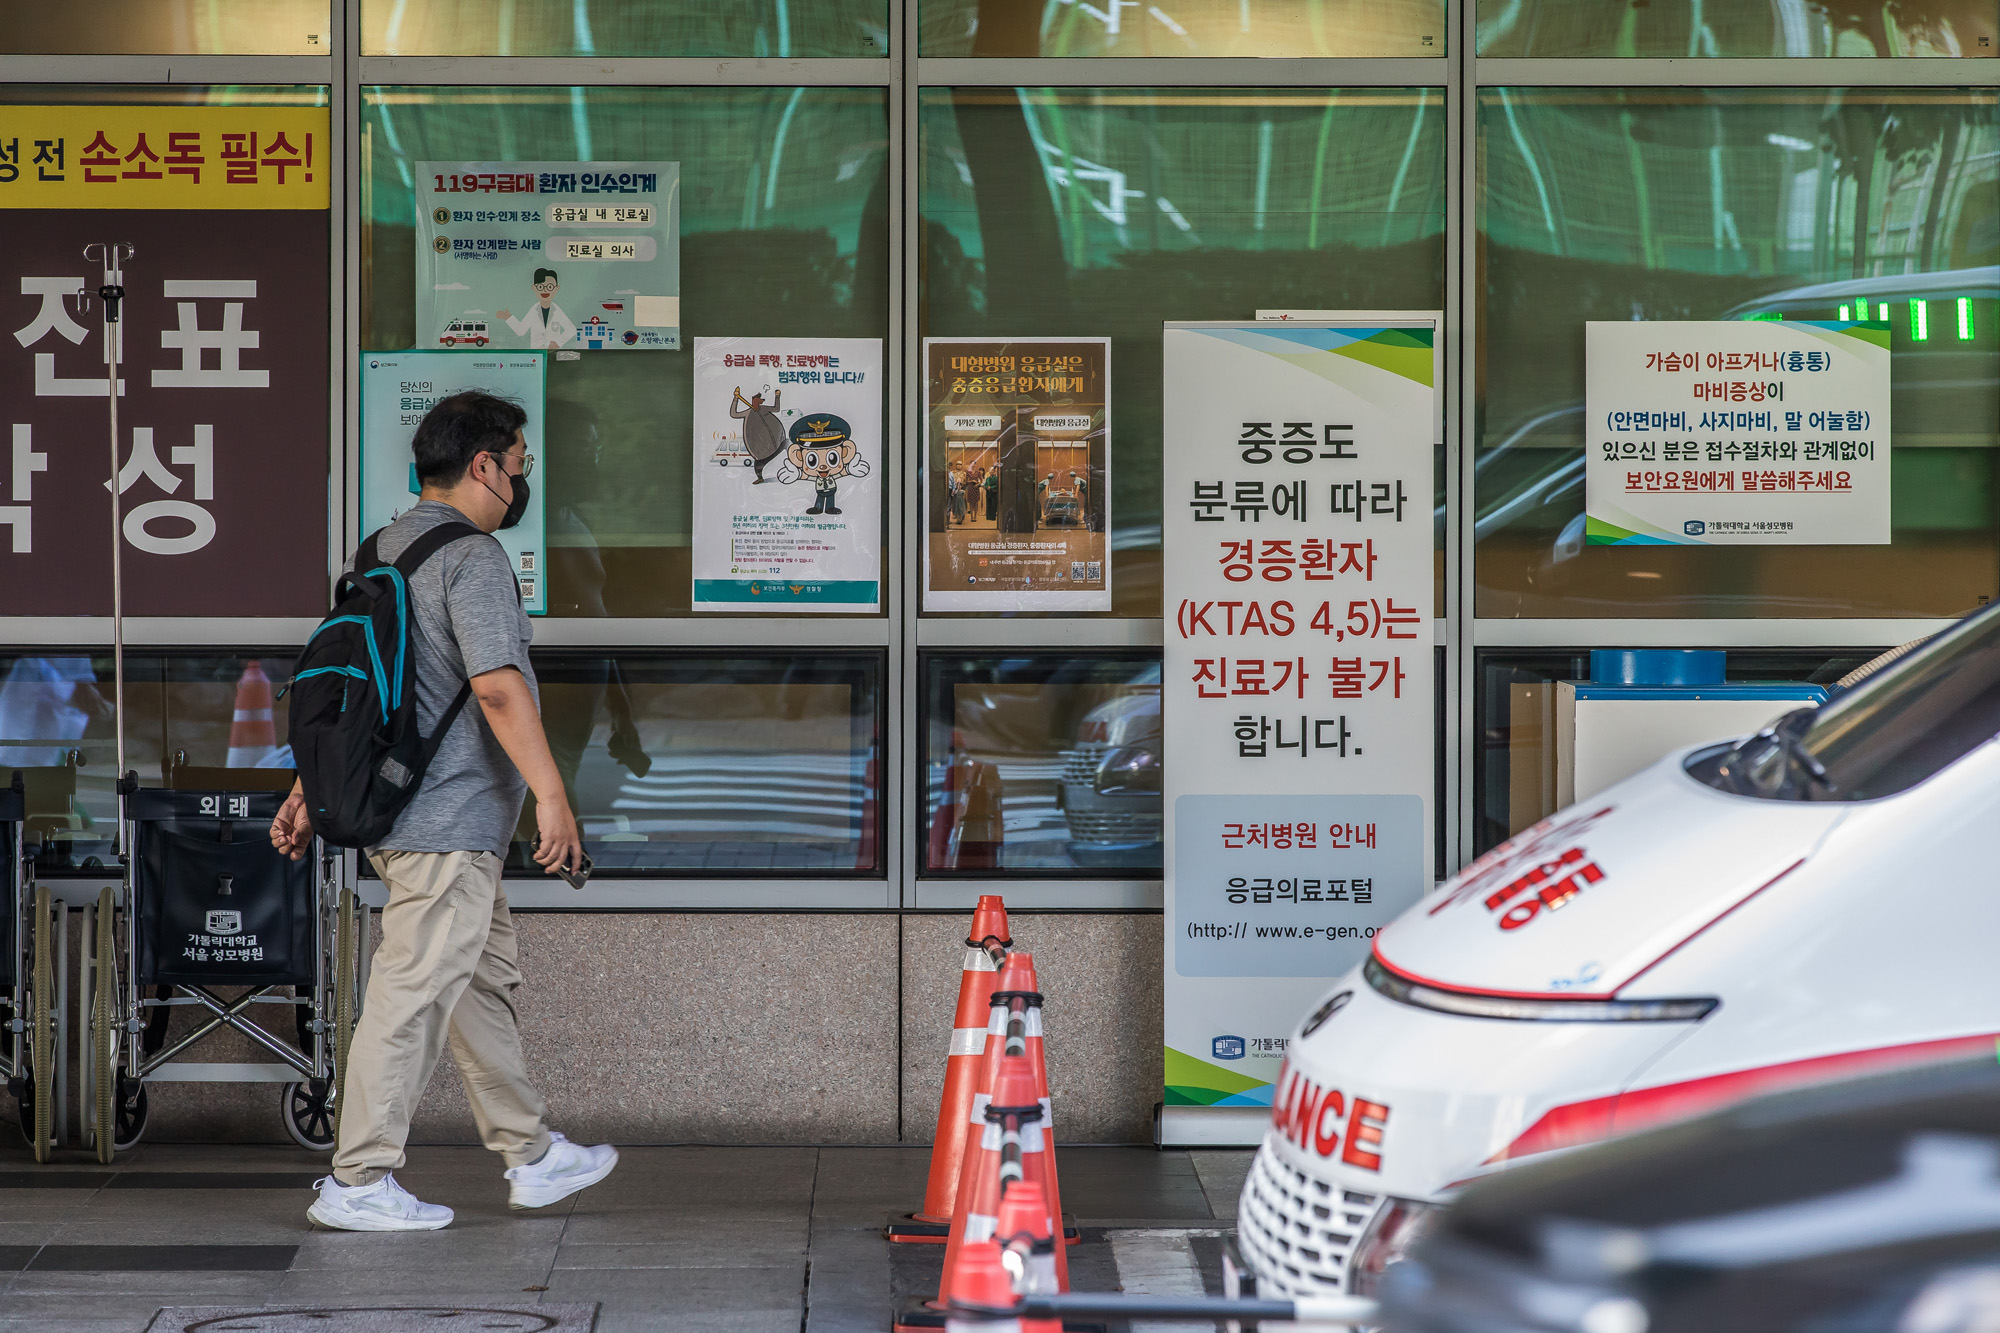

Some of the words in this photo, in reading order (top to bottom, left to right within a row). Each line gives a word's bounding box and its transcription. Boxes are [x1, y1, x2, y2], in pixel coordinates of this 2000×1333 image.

[33, 137, 66, 182] 전
[79, 130, 206, 184] 손소독
[219, 130, 314, 184] 필수!
[433, 173, 535, 193] 119구급대
[538, 172, 577, 193] 환자
[580, 172, 657, 193] 인수인계
[452, 210, 473, 222] 환자
[520, 210, 541, 222] 장소
[552, 208, 588, 222] 응급실
[595, 208, 607, 222] 내
[614, 208, 650, 222] 진료실
[452, 239, 474, 250] 환자
[476, 239, 518, 250] 인계받는
[520, 239, 541, 250] 사람
[567, 244, 604, 257] 진료실
[610, 244, 635, 257] 의사
[454, 251, 482, 260] (서명하는
[482, 251, 498, 260] 사람)
[723, 353, 756, 367] 응급실
[758, 353, 783, 369] 폭행,
[786, 354, 840, 369] 진료방해는
[951, 356, 1016, 373] 대형병원
[1020, 355, 1084, 373] 응급실은
[1645, 351, 1700, 372] 가슴이
[1706, 350, 1831, 372] 아프거나(흉통)
[778, 370, 821, 385] 범죄행위
[823, 371, 865, 385] 입니다!!
[951, 376, 1084, 393] 중증응급환자에게
[400, 381, 433, 394] 당신의
[1693, 381, 1784, 402] 마비증상이
[400, 414, 426, 426] 보여
[953, 418, 977, 427] 가까운
[977, 418, 993, 427] 병원
[1036, 418, 1066, 427] 대형병원
[1067, 418, 1089, 427] 응급실
[1606, 411, 1693, 433] (안면마비,
[1699, 411, 1778, 433] 사지마비,
[1785, 411, 1802, 431] 말
[1808, 410, 1871, 432] 어눌함)
[1237, 422, 1358, 465] 중증도
[1602, 441, 1656, 461] 있으신
[1663, 441, 1700, 461] 분은
[1705, 441, 1797, 461] 접수절차와
[1803, 441, 1874, 461] 관계없이
[1625, 470, 1735, 492] 보안요원에게
[1742, 470, 1853, 492] 말씀해주세요
[1189, 479, 1308, 523] 분류에
[1330, 479, 1408, 523] 따라
[1708, 522, 1750, 530] 가톨릭대학교
[1752, 522, 1794, 530] 서울성모병원
[1218, 538, 1378, 582] 경증환자
[1177, 598, 1296, 640] (KTAS
[1310, 598, 1421, 642] 4,5)는
[1191, 656, 1310, 699] 진료가
[1327, 656, 1406, 699] 불가
[1233, 715, 1363, 758] 합니다.
[1221, 822, 1318, 850] 근처병원
[1329, 822, 1377, 850] 안내
[1225, 877, 1374, 904] 응급의료포털
[188, 933, 258, 947] 가톨릭대학교
[1187, 921, 1247, 941] (http://
[1256, 921, 1383, 941] www.e-gen.or
[182, 947, 209, 962] 서울
[211, 947, 264, 962] 성모병원
[1251, 1038, 1291, 1051] 가톨릭
